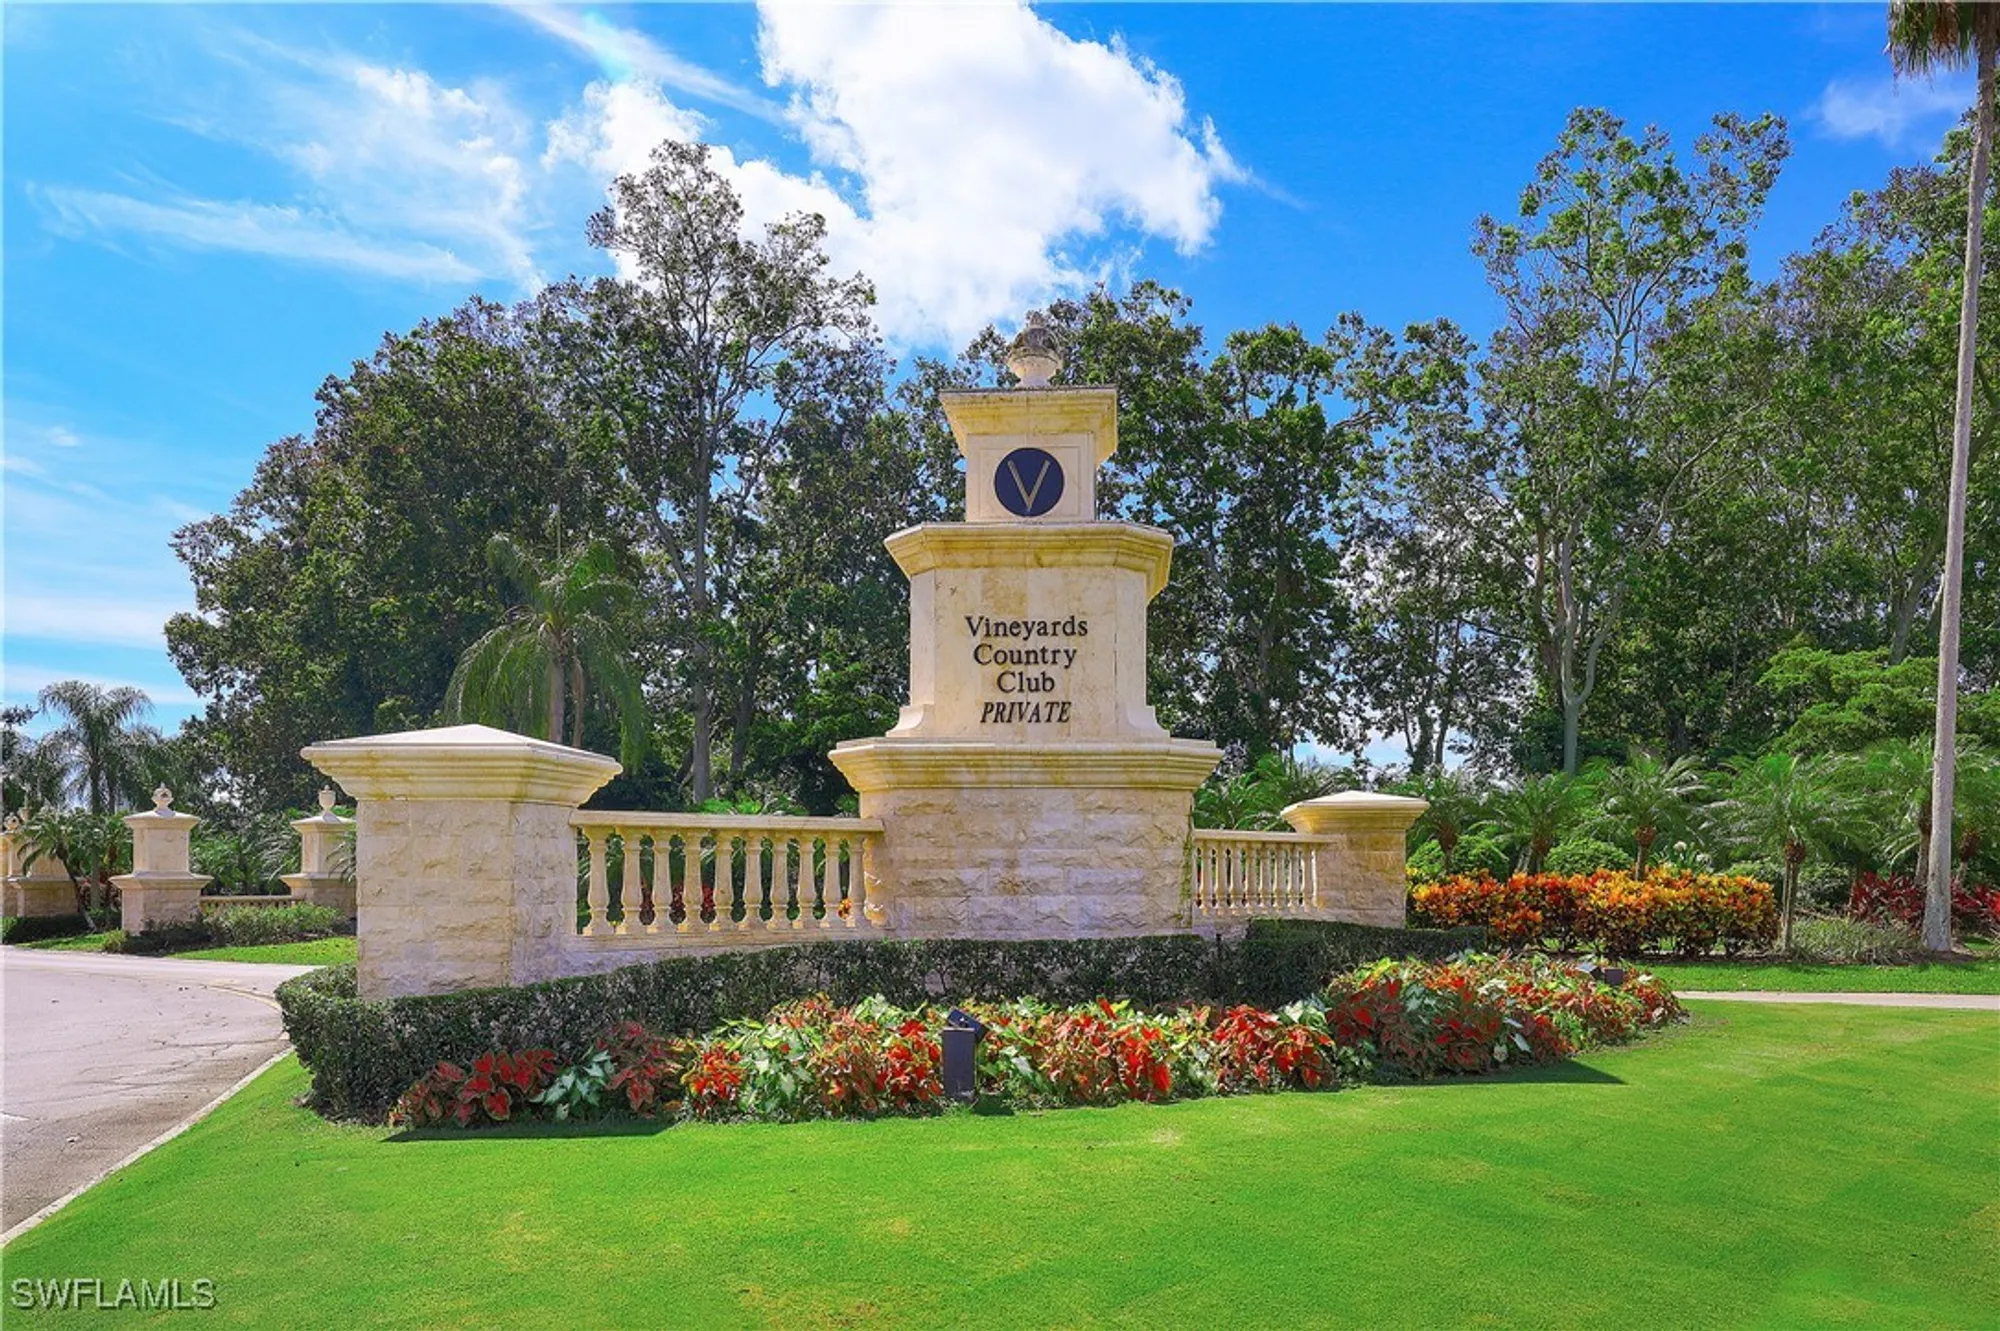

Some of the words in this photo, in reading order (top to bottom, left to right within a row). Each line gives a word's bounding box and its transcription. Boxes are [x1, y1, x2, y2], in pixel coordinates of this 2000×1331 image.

[1007, 460, 1051, 512] V
[964, 615, 1089, 640] Vineyards
[973, 643, 1077, 668] Country
[996, 670, 1056, 694] Club
[979, 701, 1072, 724] PRIVATE
